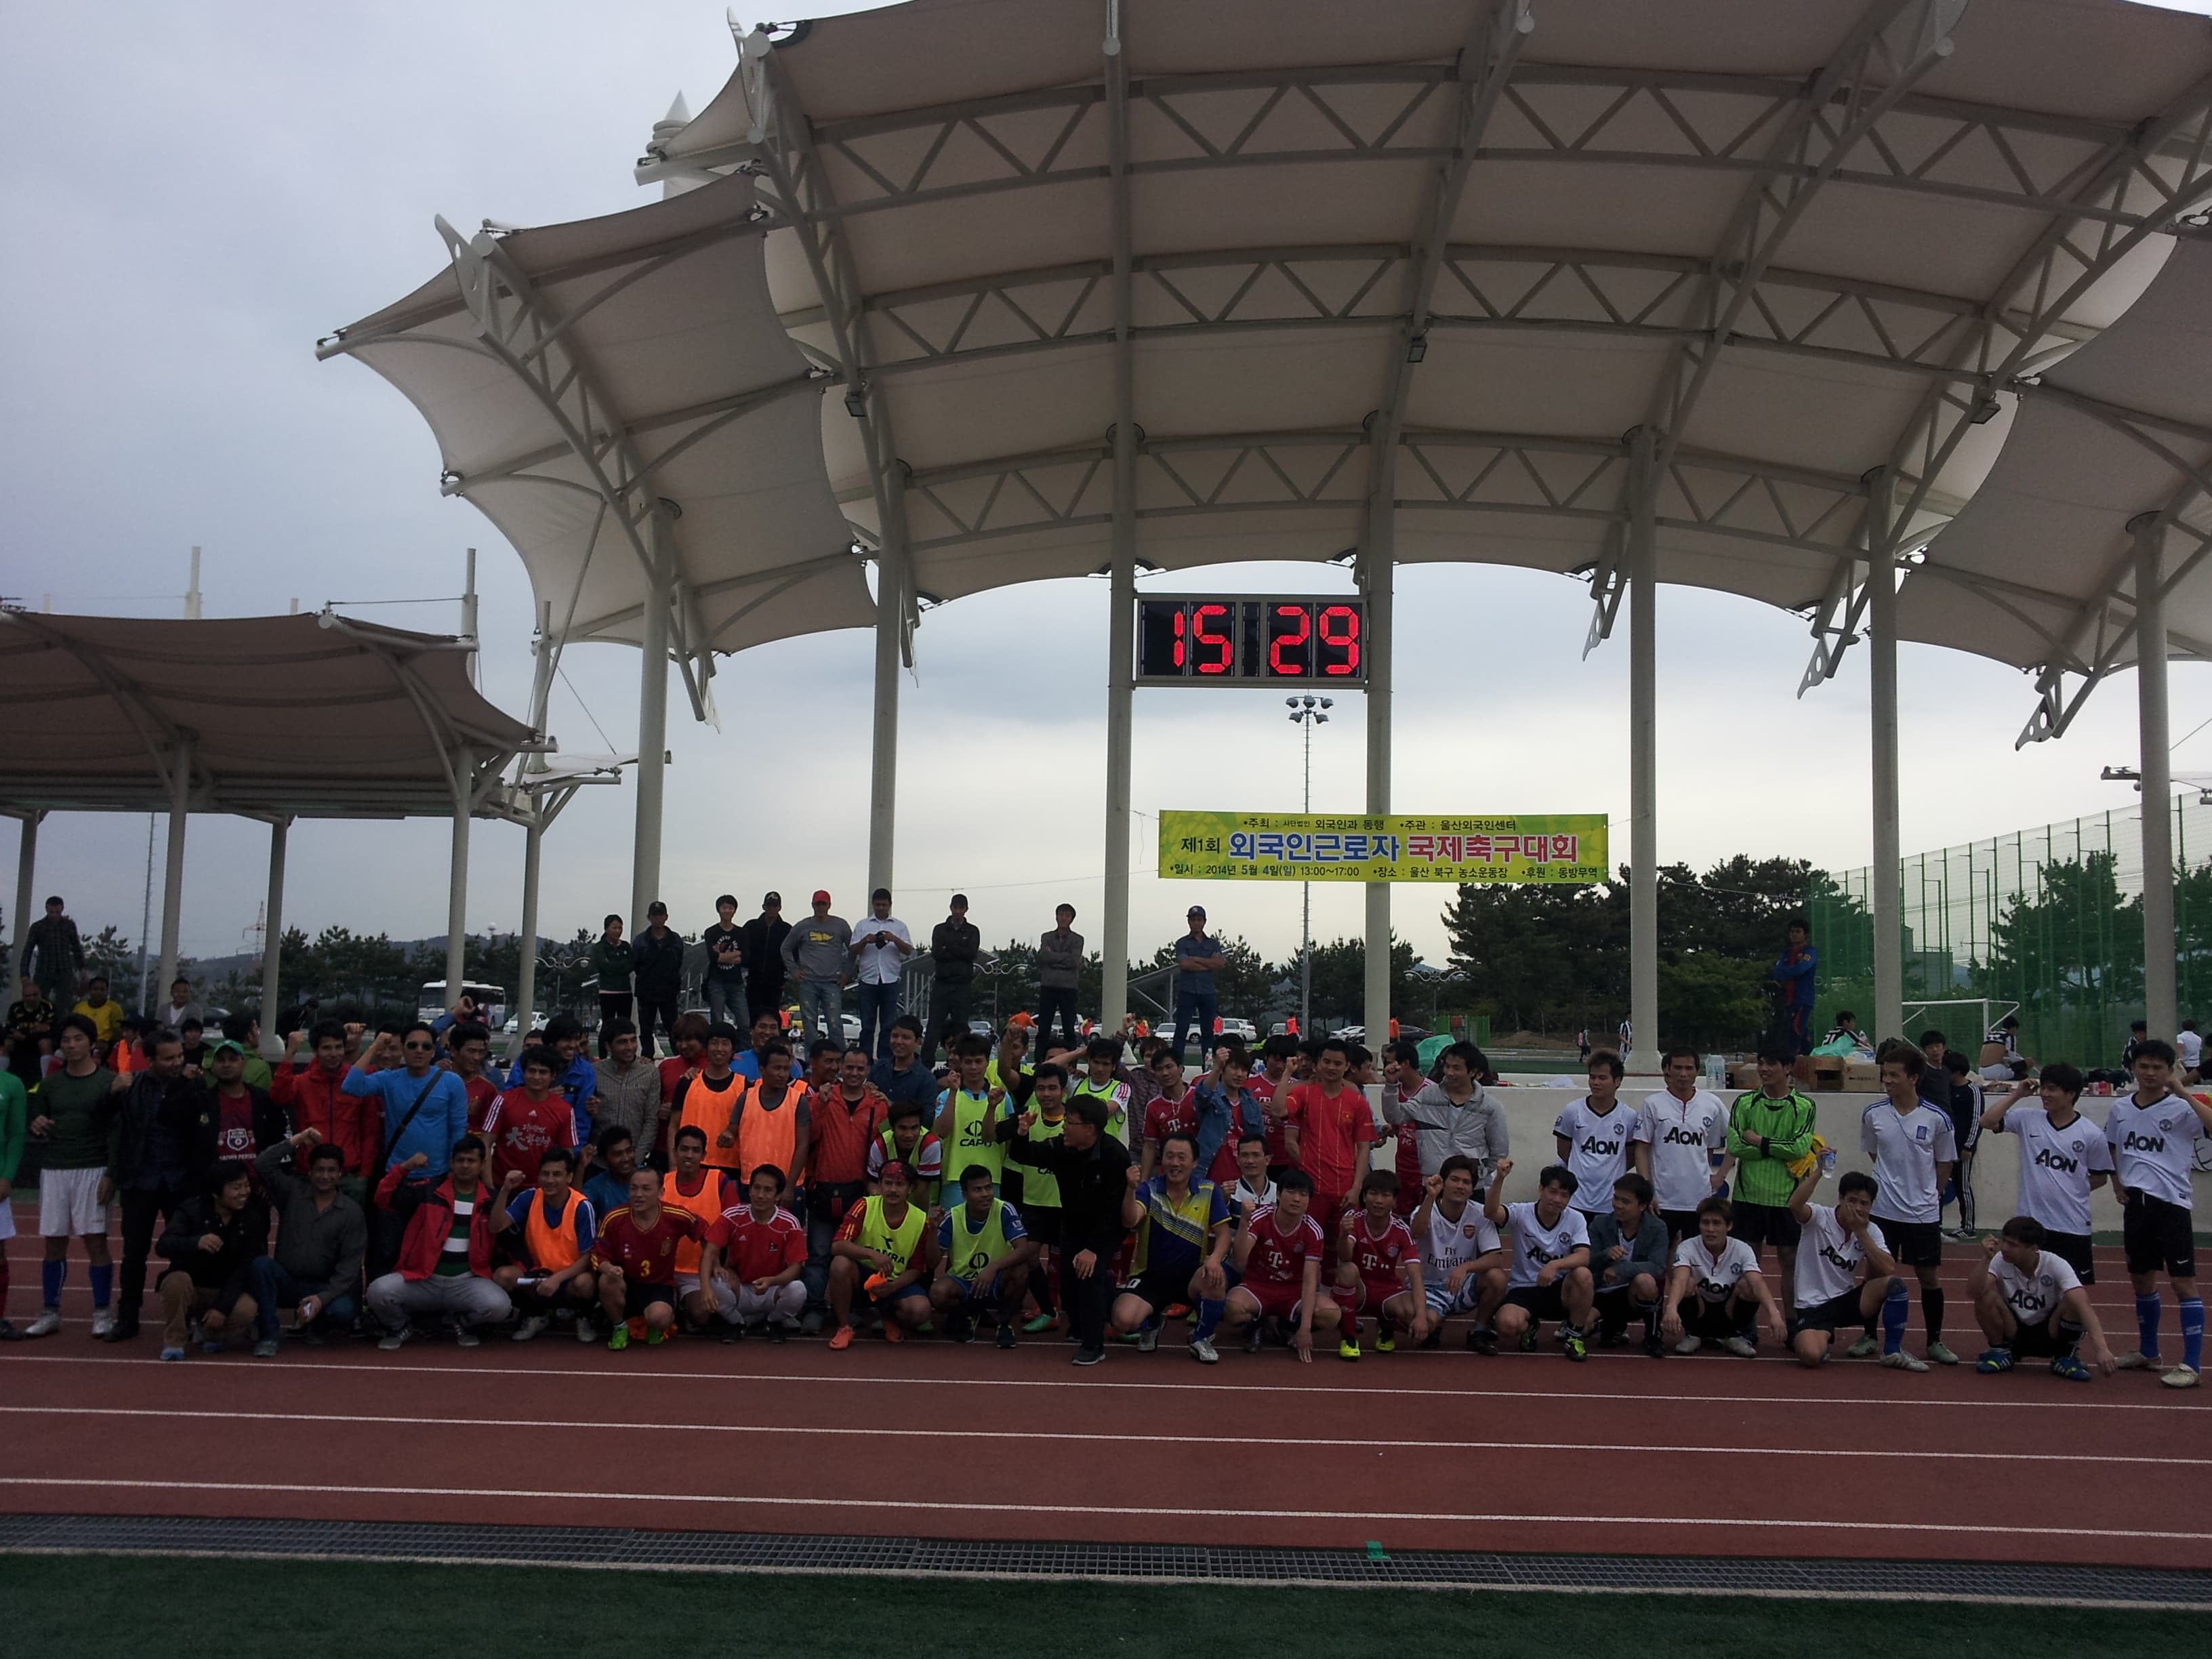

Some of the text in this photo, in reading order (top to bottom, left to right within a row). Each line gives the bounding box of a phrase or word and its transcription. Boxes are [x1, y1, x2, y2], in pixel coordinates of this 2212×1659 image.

[1173, 605, 1359, 674] 15 29
[1248, 818, 1269, 828] 주최
[1283, 819, 1311, 827] 사단법인
[1315, 819, 1358, 830] 외국인과
[1363, 820, 1385, 830] 동행
[1405, 820, 1427, 830] 주관
[1440, 820, 1517, 831] 울산외국인센터
[1181, 832, 1576, 863] 제1회 외국인근로자 국제축구대회
[1174, 863, 1193, 874] 일시
[1206, 865, 1236, 876] 2014년
[1241, 865, 1258, 876] 5월
[1263, 865, 1296, 876] 4일(일)
[1300, 867, 1359, 876] 13:00~17:00
[1378, 867, 1397, 878] 장소
[1410, 867, 1430, 878] 울산
[1434, 867, 1454, 878] 북구
[1458, 867, 1509, 878] 농소운동장
[1525, 867, 1546, 878] 후원
[1558, 867, 1598, 878] 동방무역
[640, 1258, 651, 1277] 3
[1427, 1253, 1471, 1269] Emirat
